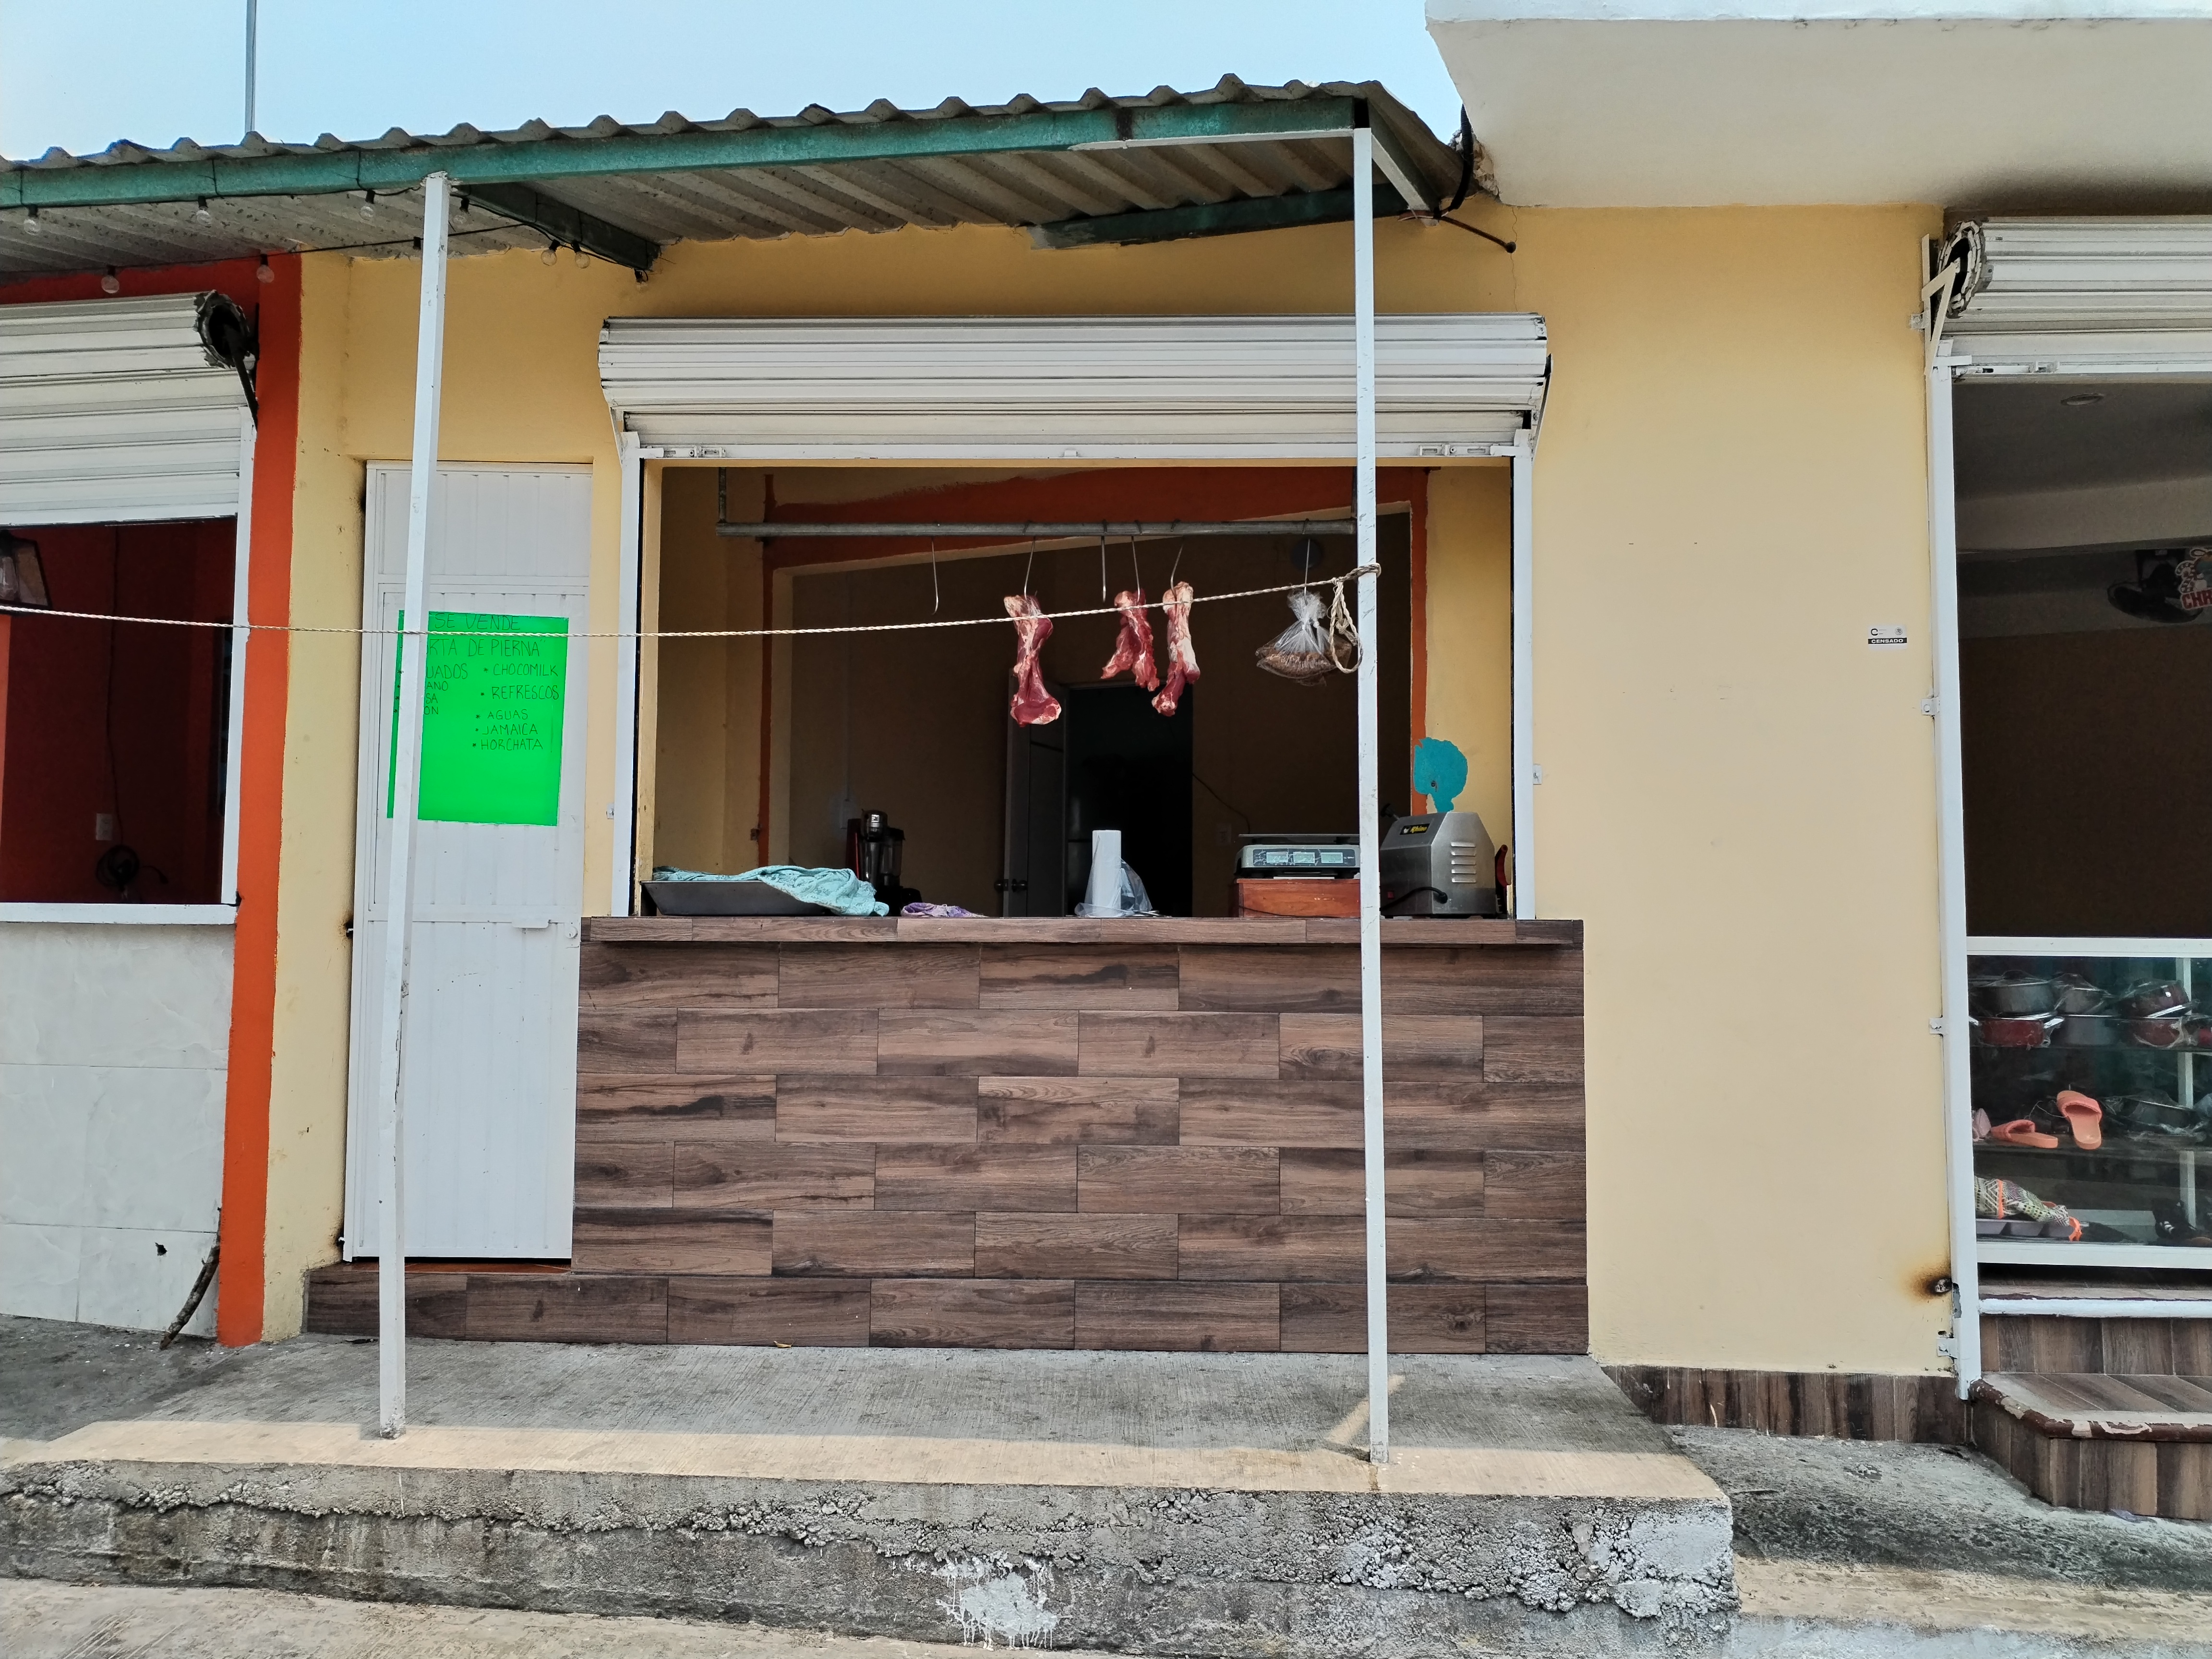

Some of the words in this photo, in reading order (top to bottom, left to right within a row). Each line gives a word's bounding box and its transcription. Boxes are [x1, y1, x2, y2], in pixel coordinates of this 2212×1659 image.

[466, 614, 520, 631] VENDE
[429, 638, 457, 656] RTA
[467, 638, 484, 657] DE
[426, 663, 468, 680] UADOS
[493, 663, 558, 677] CHOCOMILK
[426, 681, 448, 691] ANO
[425, 693, 438, 704] SA
[492, 685, 559, 700] REFRESCOS
[423, 706, 439, 715] ON
[487, 709, 528, 720] AGUAS
[481, 723, 538, 735] JAMAICA
[481, 738, 543, 751] HORCHATA
[1410, 826, 1428, 834] Rhino
